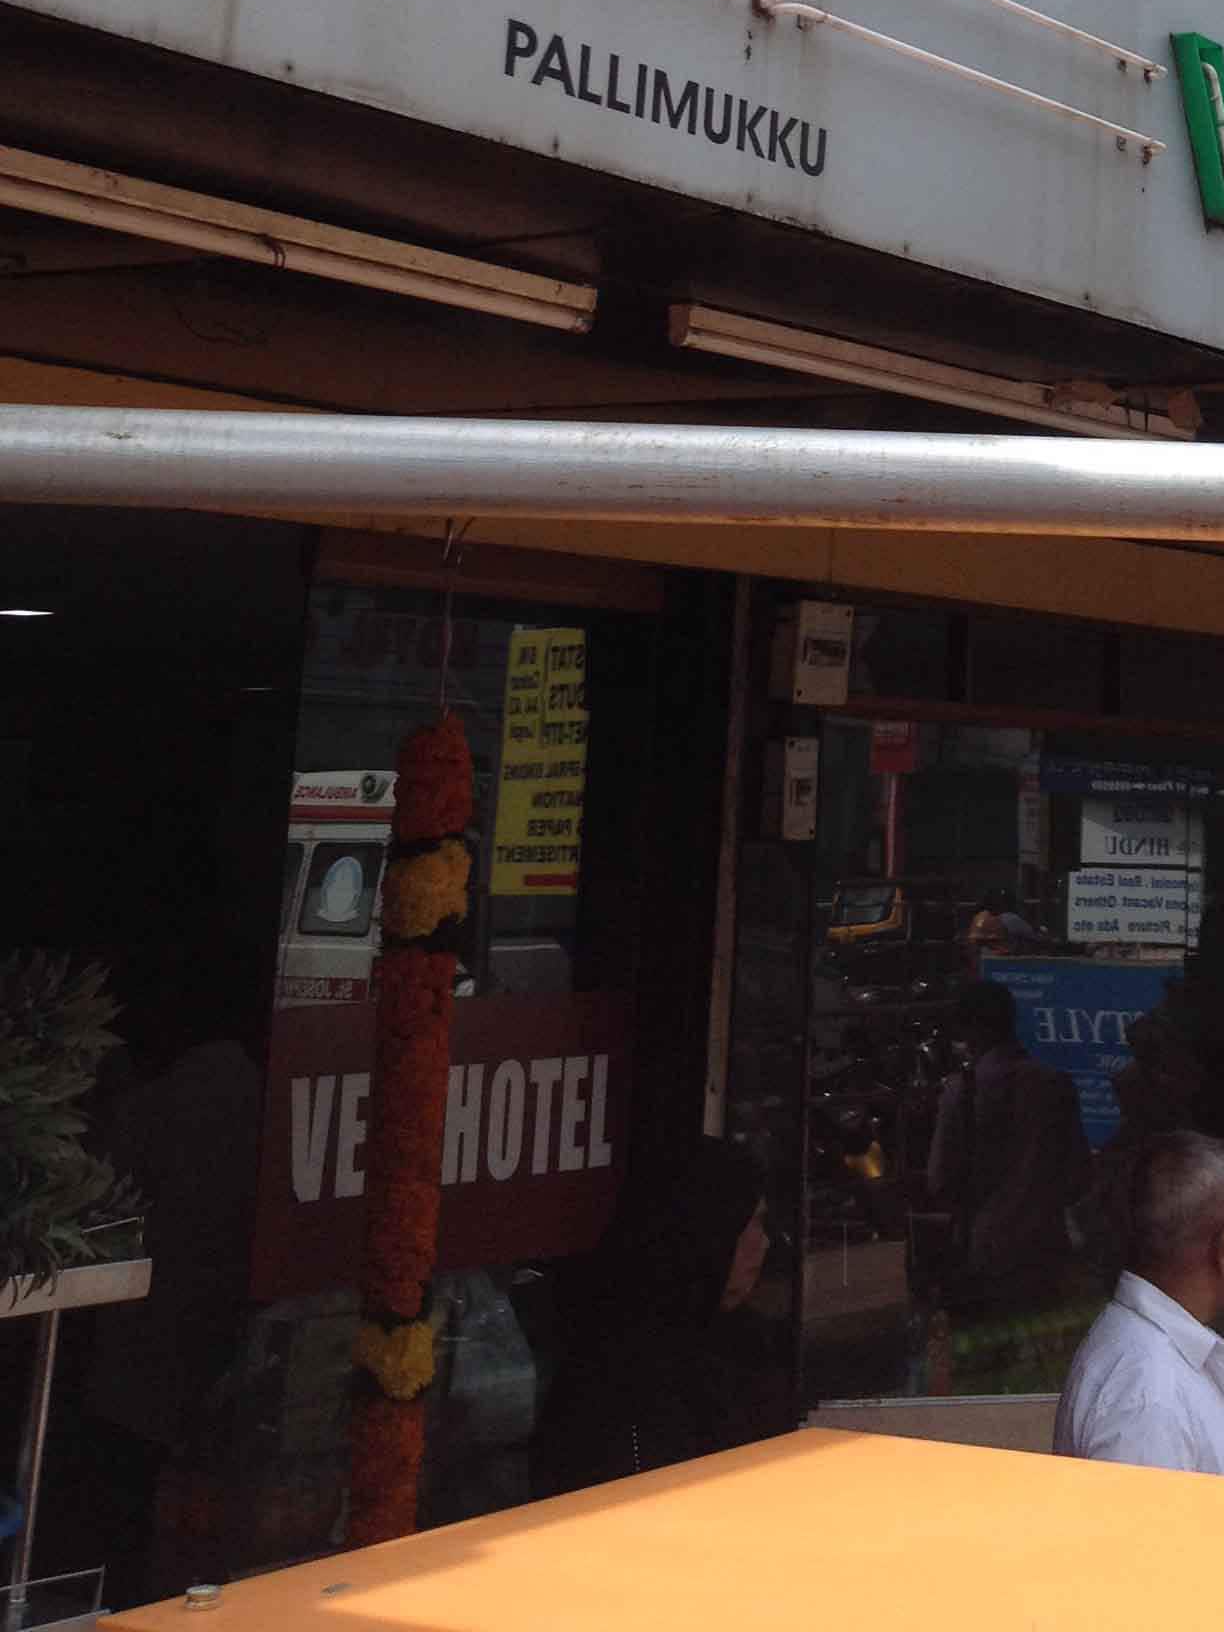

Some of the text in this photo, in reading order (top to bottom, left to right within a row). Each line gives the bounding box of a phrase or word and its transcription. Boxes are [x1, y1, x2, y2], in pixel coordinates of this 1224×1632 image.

[503, 18, 827, 177] PALLIMUKKU
[290, 1053, 613, 1202] VE HOTEL
